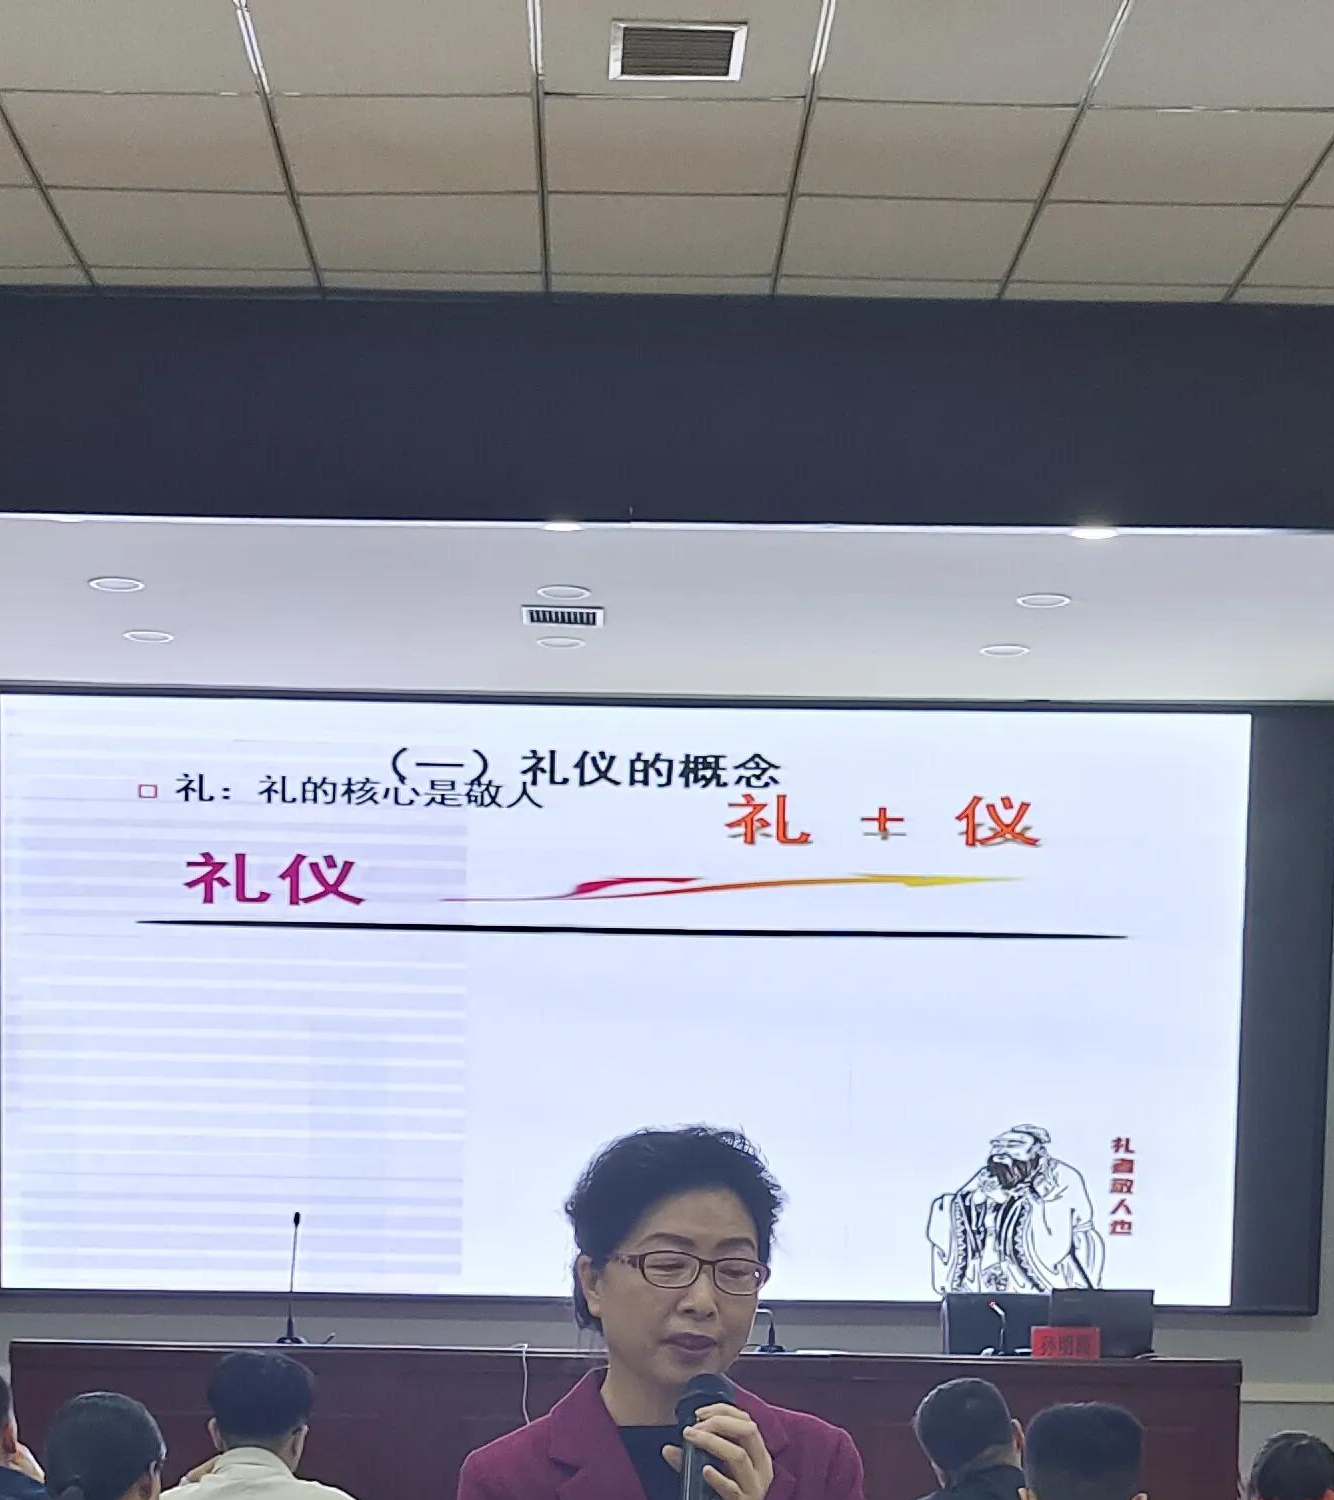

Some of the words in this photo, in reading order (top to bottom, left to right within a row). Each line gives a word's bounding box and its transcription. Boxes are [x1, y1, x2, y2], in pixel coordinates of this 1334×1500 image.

[175, 773, 544, 810] 礼：礼的核心是敬人
[724, 793, 811, 847] 礼
[955, 795, 1042, 848] 仪
[184, 852, 365, 905] 礼仪
